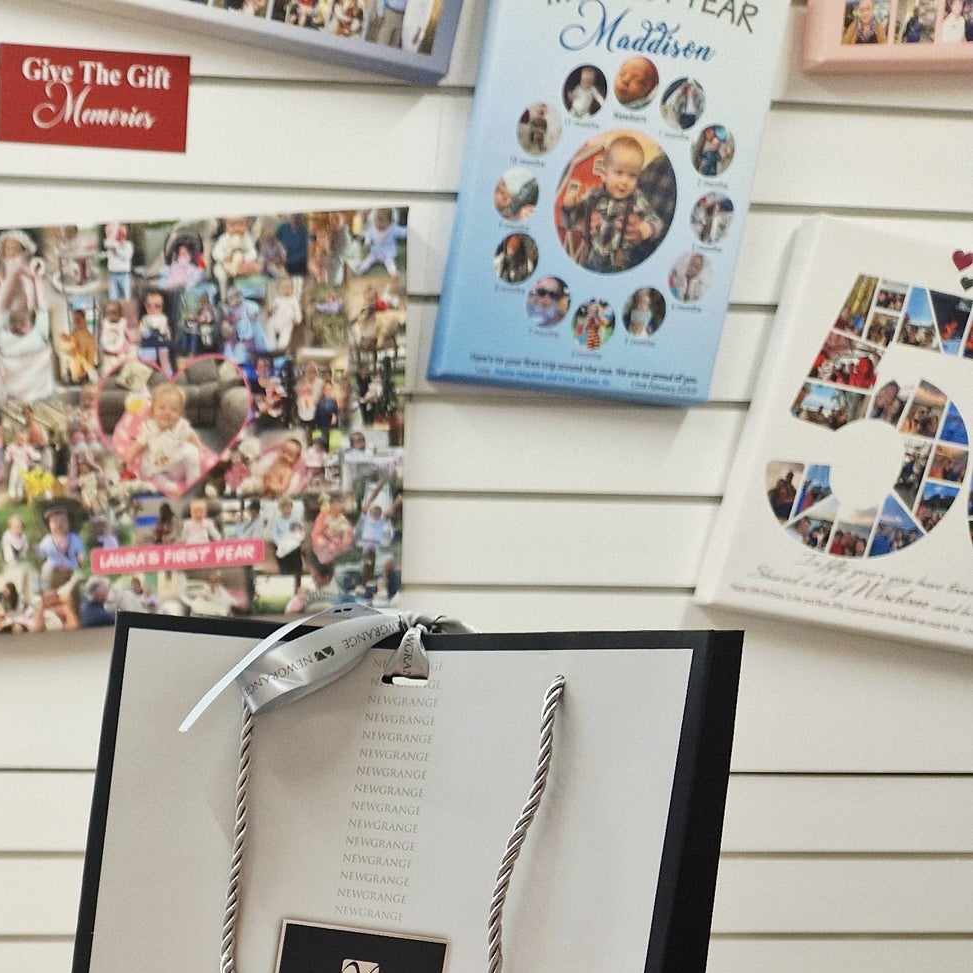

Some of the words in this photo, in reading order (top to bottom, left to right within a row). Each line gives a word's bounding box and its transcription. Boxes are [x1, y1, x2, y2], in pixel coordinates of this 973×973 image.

[559, 0, 715, 62] Maddison
[21, 56, 75, 84] Give
[78, 60, 122, 87] The
[126, 64, 172, 90] Gift
[31, 79, 157, 130] Memories
[99, 550, 160, 570] LAURA'S
[163, 546, 211, 566] FIRST
[214, 543, 256, 564] YEAR
[368, 694, 438, 708] NEWGRANGE
[365, 712, 436, 726] NEWGRANGE
[362, 730, 433, 744] NEWGRANGE
[359, 748, 430, 762] NEWGRANGE
[356, 766, 427, 780] NEWGRANGE
[353, 783, 424, 798] NEWGRANGE
[351, 801, 421, 816] NEWGRANGE
[348, 818, 418, 833] NEWGRANGE
[345, 836, 415, 851] NEWGRANGE
[342, 853, 412, 869] NEWGRANGE
[339, 870, 409, 887] NEWGRANGE
[337, 888, 407, 904] NEWGRANGE
[334, 905, 404, 922] NEWGRANGE
